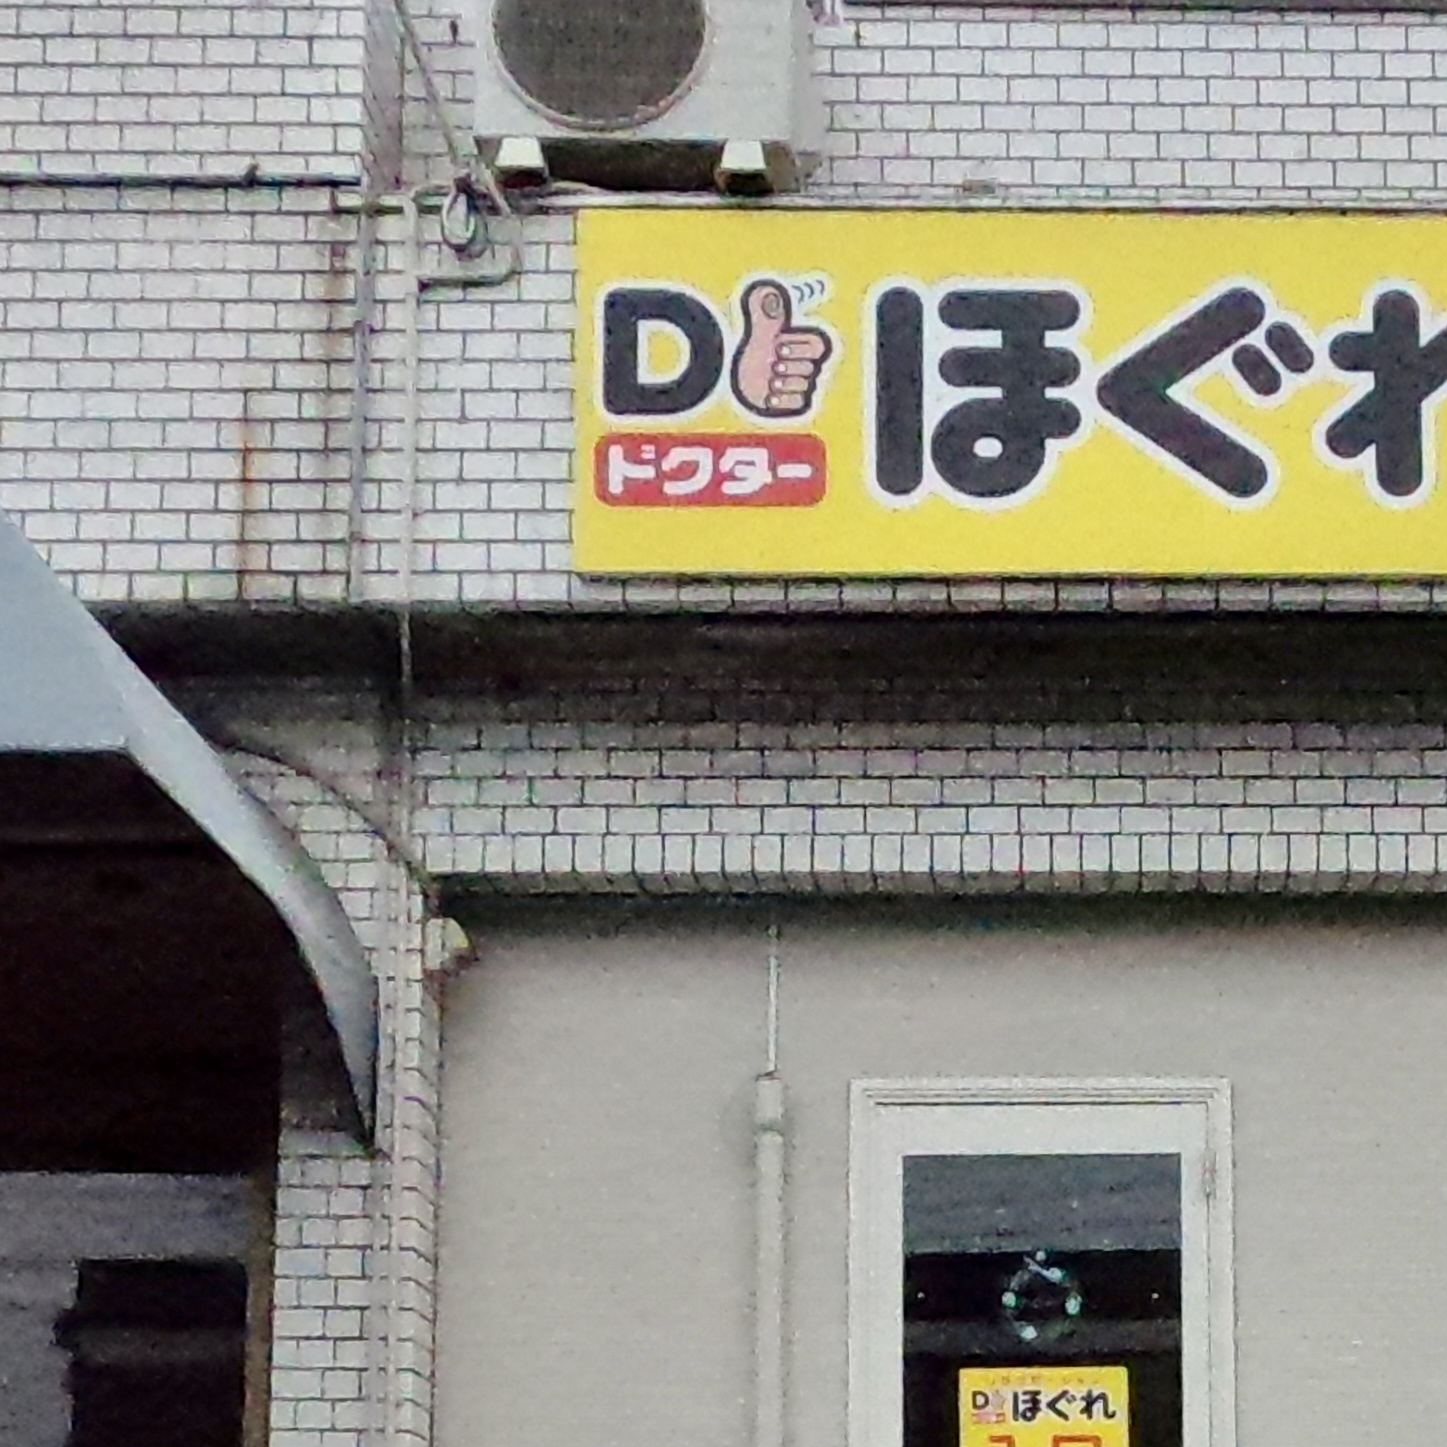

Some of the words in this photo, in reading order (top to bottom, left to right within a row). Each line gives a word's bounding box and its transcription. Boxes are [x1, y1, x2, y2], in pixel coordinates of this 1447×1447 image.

[607, 444, 813, 496] ドクター
[1012, 1388, 1117, 1423] ほぐれ
